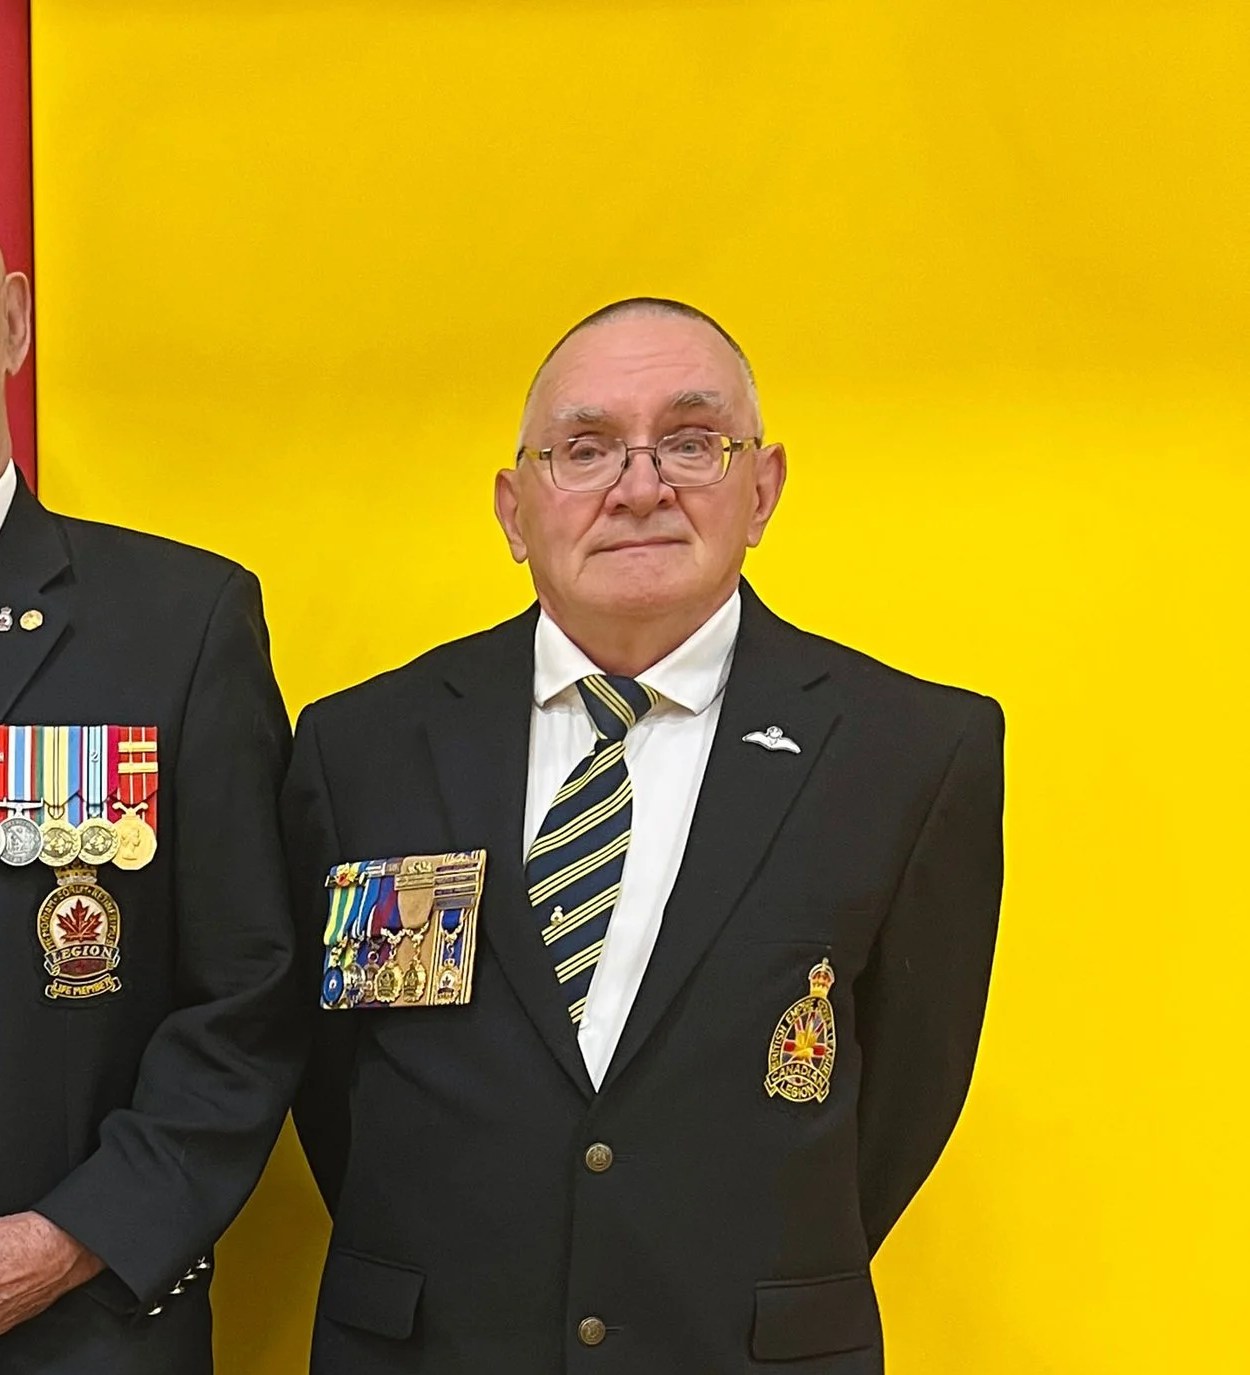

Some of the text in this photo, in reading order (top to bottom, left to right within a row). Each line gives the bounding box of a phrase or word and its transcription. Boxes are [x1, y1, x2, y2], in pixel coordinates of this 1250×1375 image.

[51, 945, 113, 963] LEGION
[55, 977, 111, 996] LIFE MEMBER
[771, 1064, 826, 1090] CANADIAN
[780, 1081, 816, 1099] LEGION
